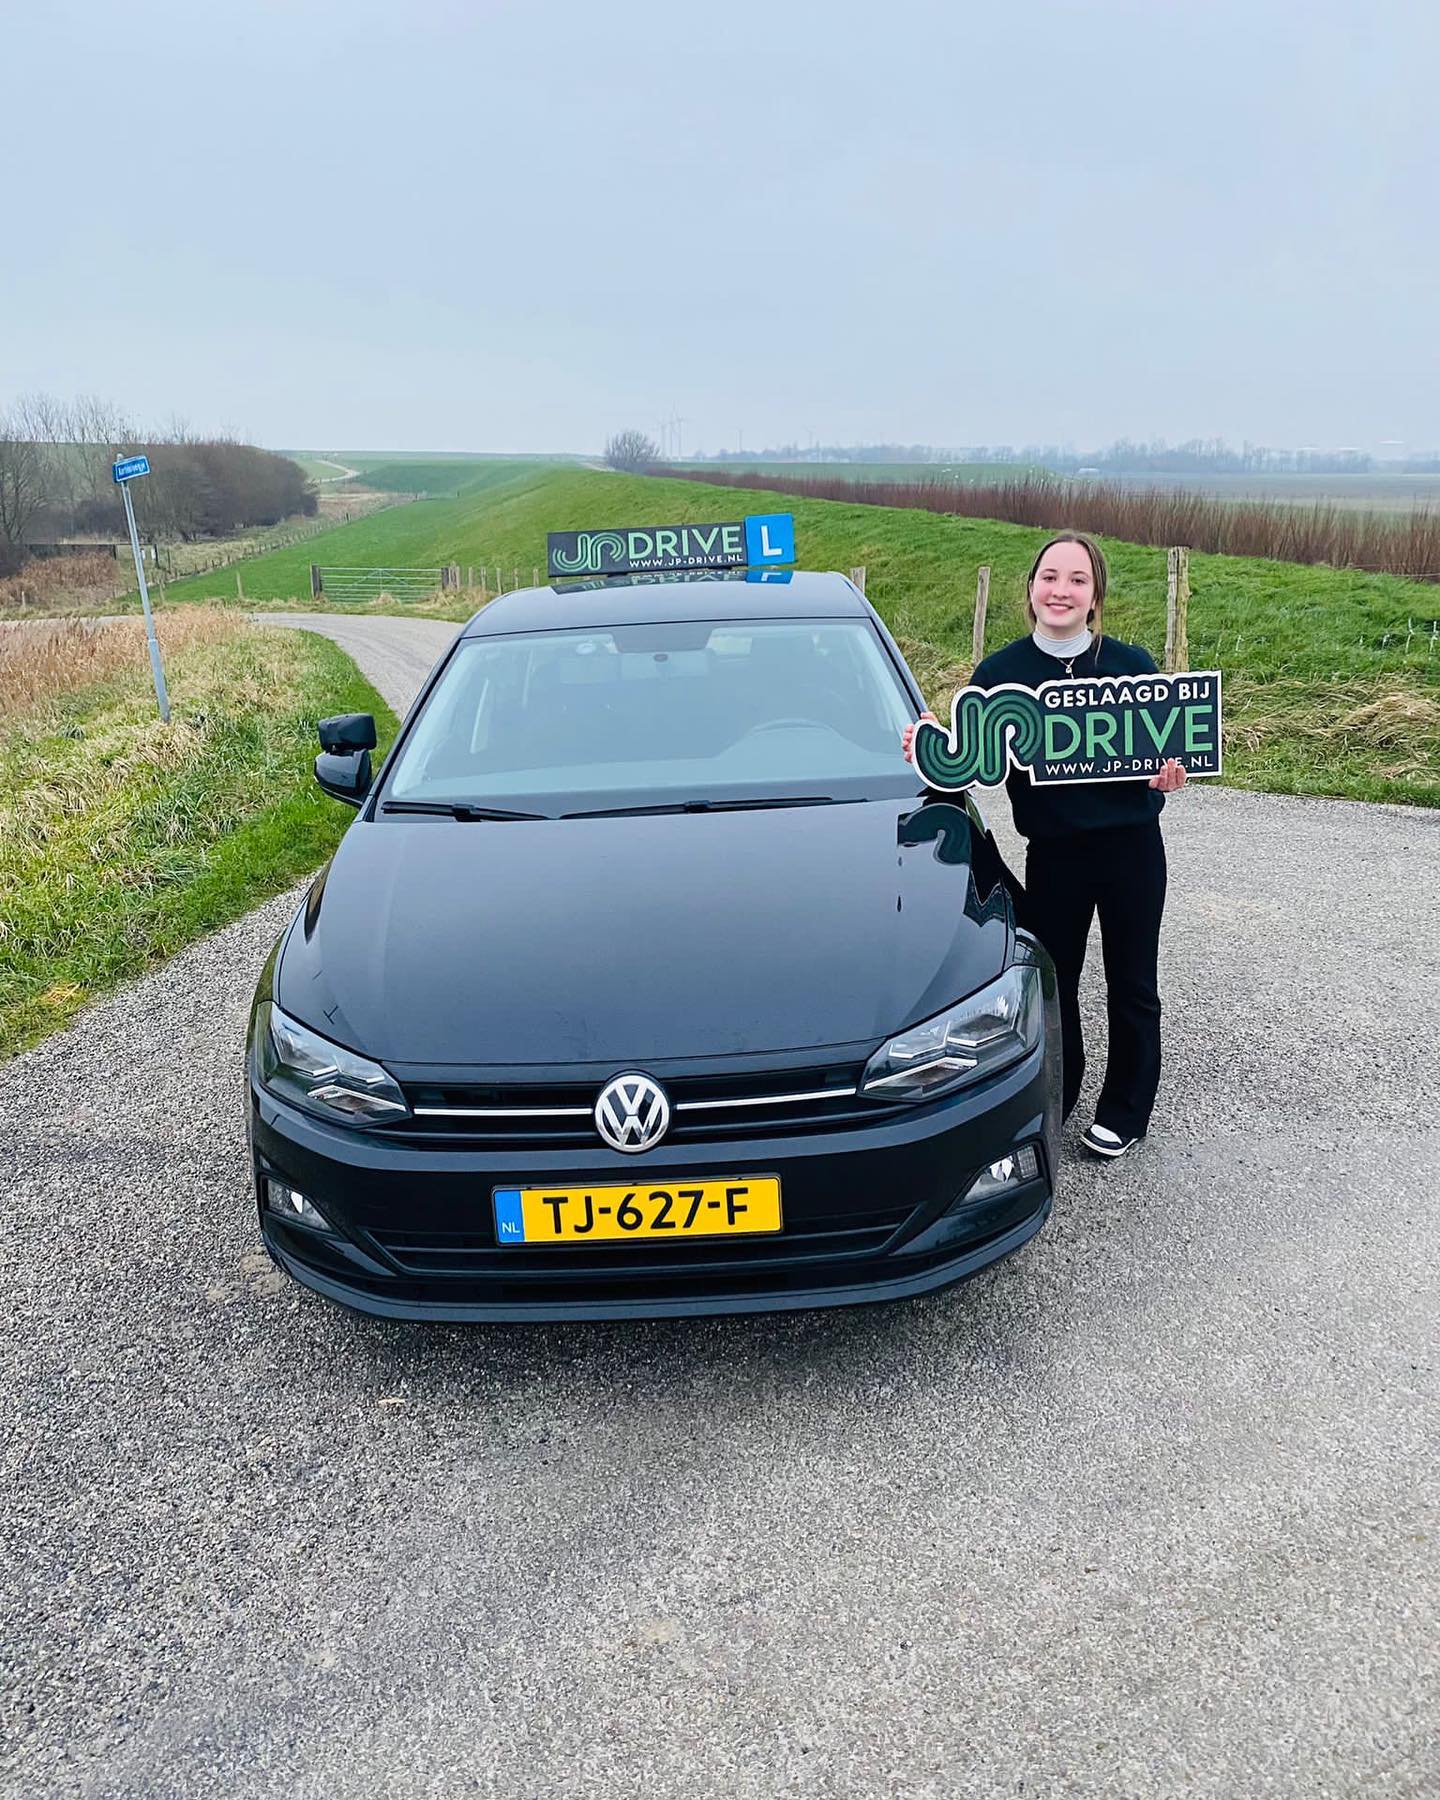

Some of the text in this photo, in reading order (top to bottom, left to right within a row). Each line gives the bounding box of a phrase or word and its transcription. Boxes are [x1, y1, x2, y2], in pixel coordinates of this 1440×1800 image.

[628, 525, 743, 559] DRIVE
[760, 525, 783, 557] L
[629, 554, 744, 568] WWW.JP-DRIVE.NL
[1044, 681, 1211, 708] GESLAAGD BIJ
[1045, 704, 1214, 760] DRIVE
[542, 1187, 749, 1234] TJ-627-F
[502, 1222, 520, 1234] NL
